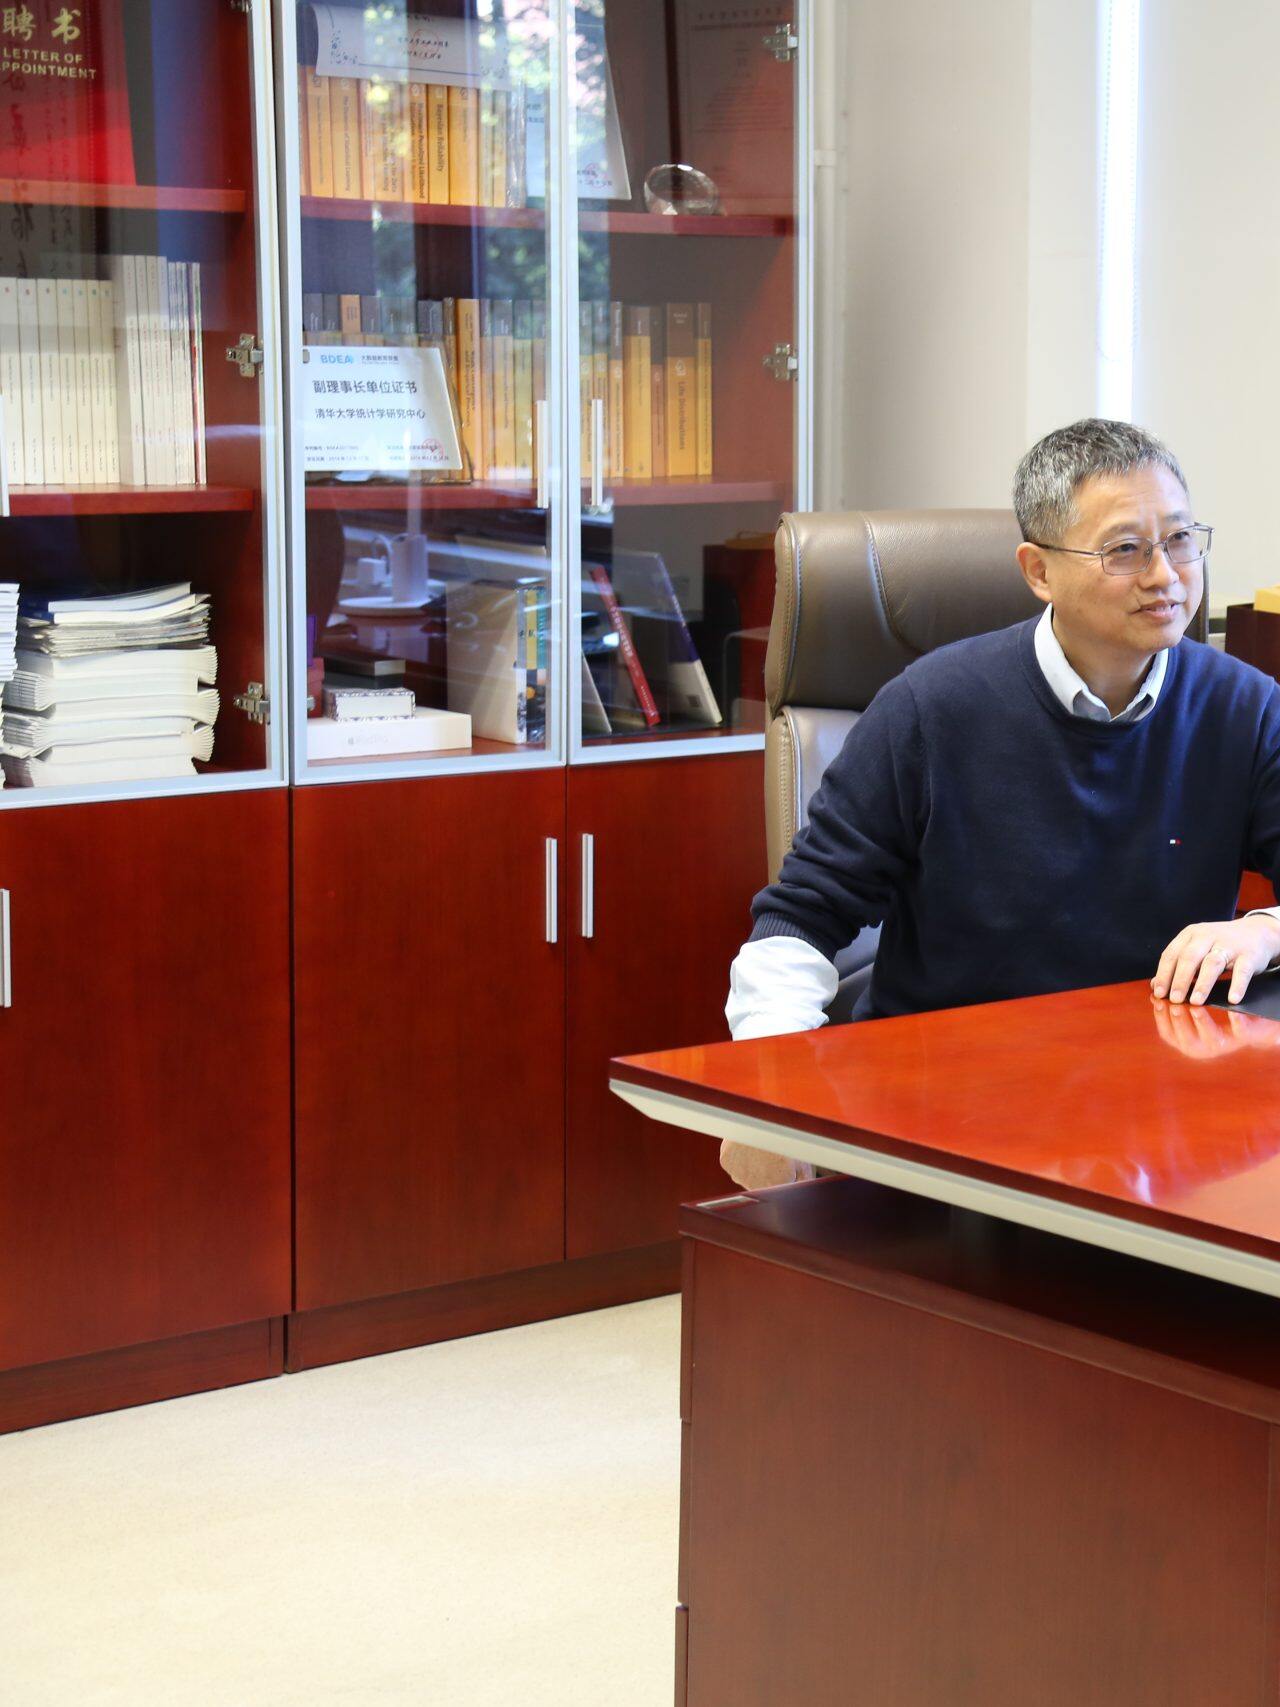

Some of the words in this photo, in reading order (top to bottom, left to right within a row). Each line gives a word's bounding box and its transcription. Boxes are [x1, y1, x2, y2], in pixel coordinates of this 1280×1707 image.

[2, 4, 81, 44] 聘书
[3, 47, 60, 62] LETTER
[64, 53, 83, 63] OF
[0, 61, 97, 79] PPOINTMENT
[436, 136, 444, 172] Reliability
[312, 379, 418, 394] 副理事长单位证书
[315, 408, 427, 420] 清华大学统计学研究中心
[678, 398, 686, 450] Distributions
